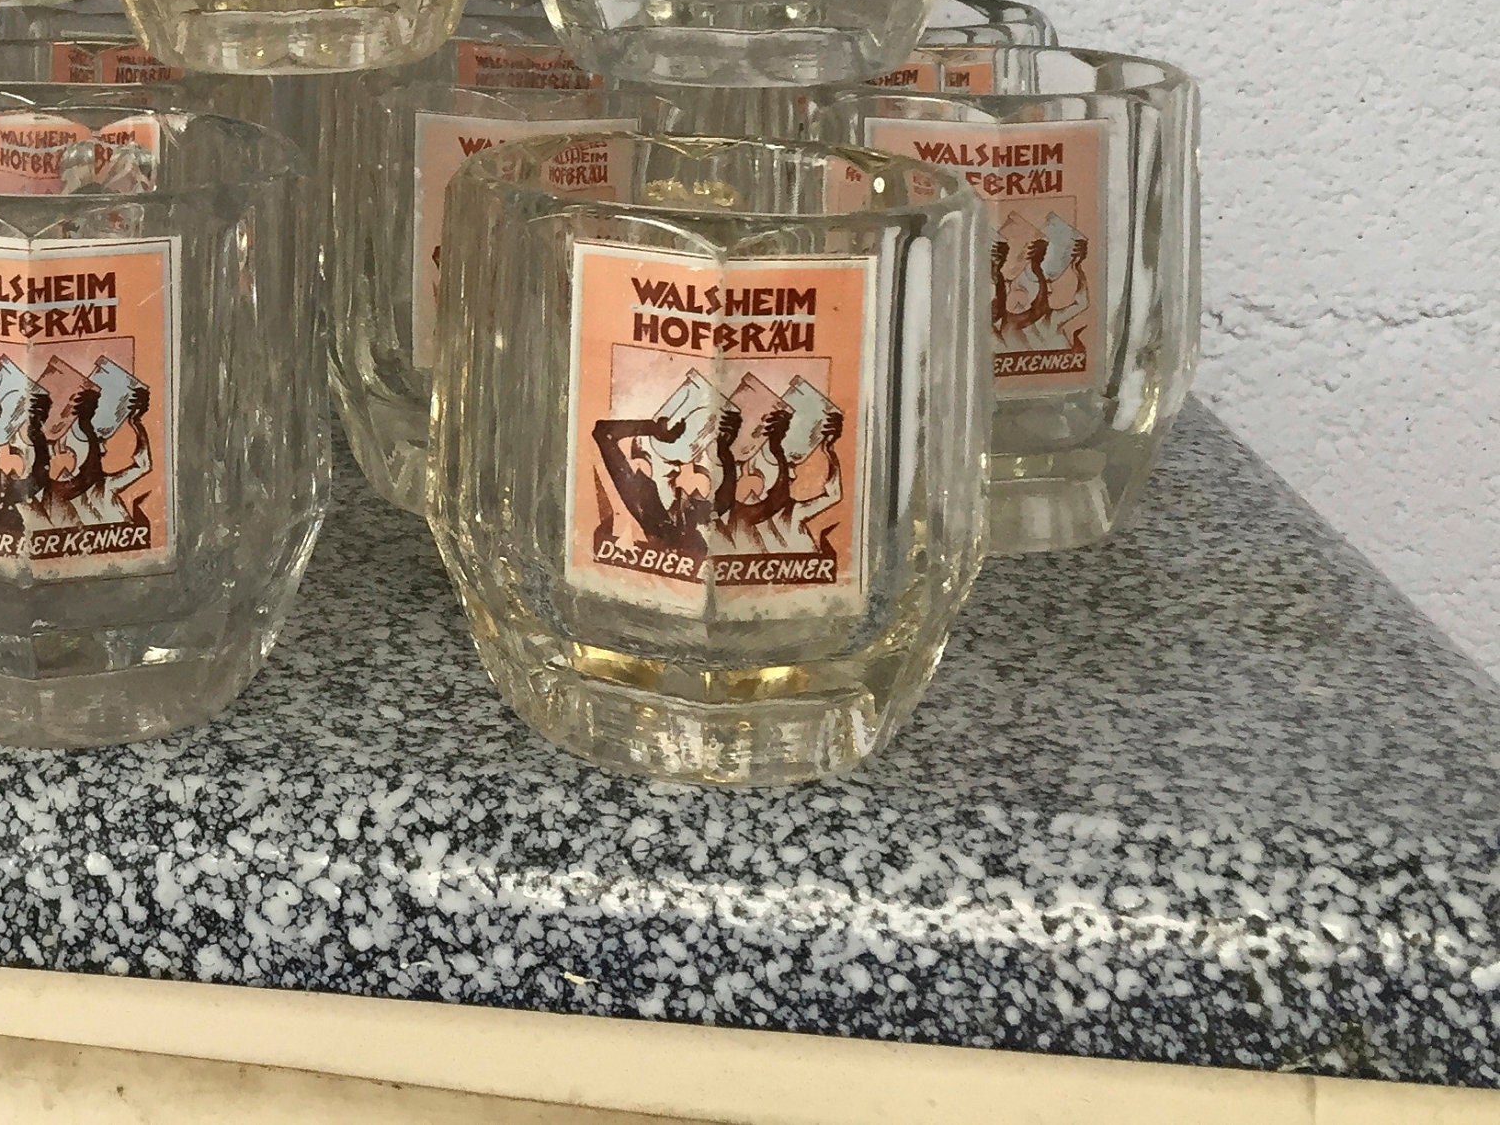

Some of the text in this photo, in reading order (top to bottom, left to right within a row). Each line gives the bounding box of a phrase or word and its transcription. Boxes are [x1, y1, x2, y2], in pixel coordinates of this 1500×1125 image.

[0, 130, 77, 148] WALSHEIM
[913, 141, 1064, 167] WALSHEIM
[965, 167, 1063, 196] FBRÄU
[631, 277, 817, 316] WALSHEIM
[633, 313, 815, 354] HOFBRÄU
[994, 353, 1085, 373] ER KENNER
[61, 525, 148, 553] KENNER
[745, 557, 835, 582] KENNER
